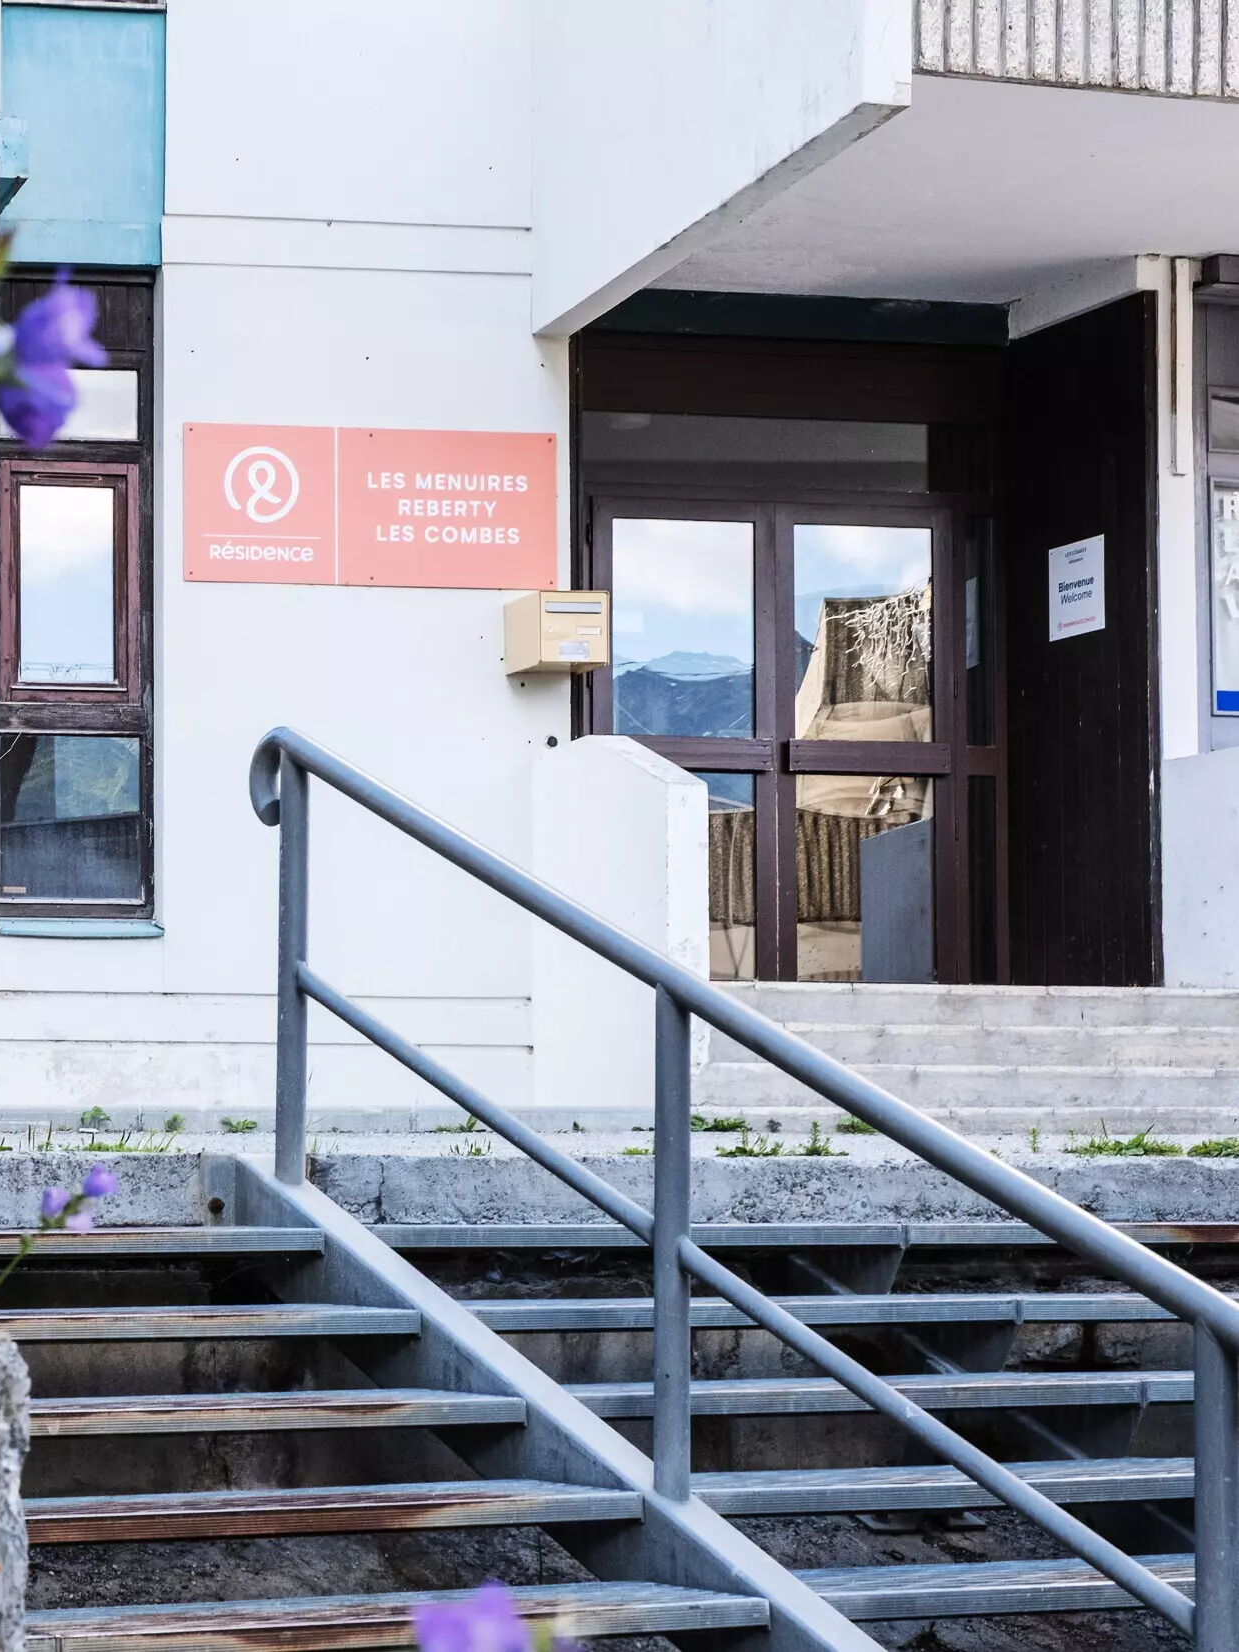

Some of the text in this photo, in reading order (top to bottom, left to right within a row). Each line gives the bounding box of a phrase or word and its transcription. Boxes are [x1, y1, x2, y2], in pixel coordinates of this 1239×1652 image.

[367, 471, 528, 492] LES MENUIRES
[398, 499, 497, 518] REBERTY
[376, 524, 520, 545] LES COMBES
[1058, 576, 1095, 593] Bienvenue
[1060, 589, 1093, 605] Welcome
